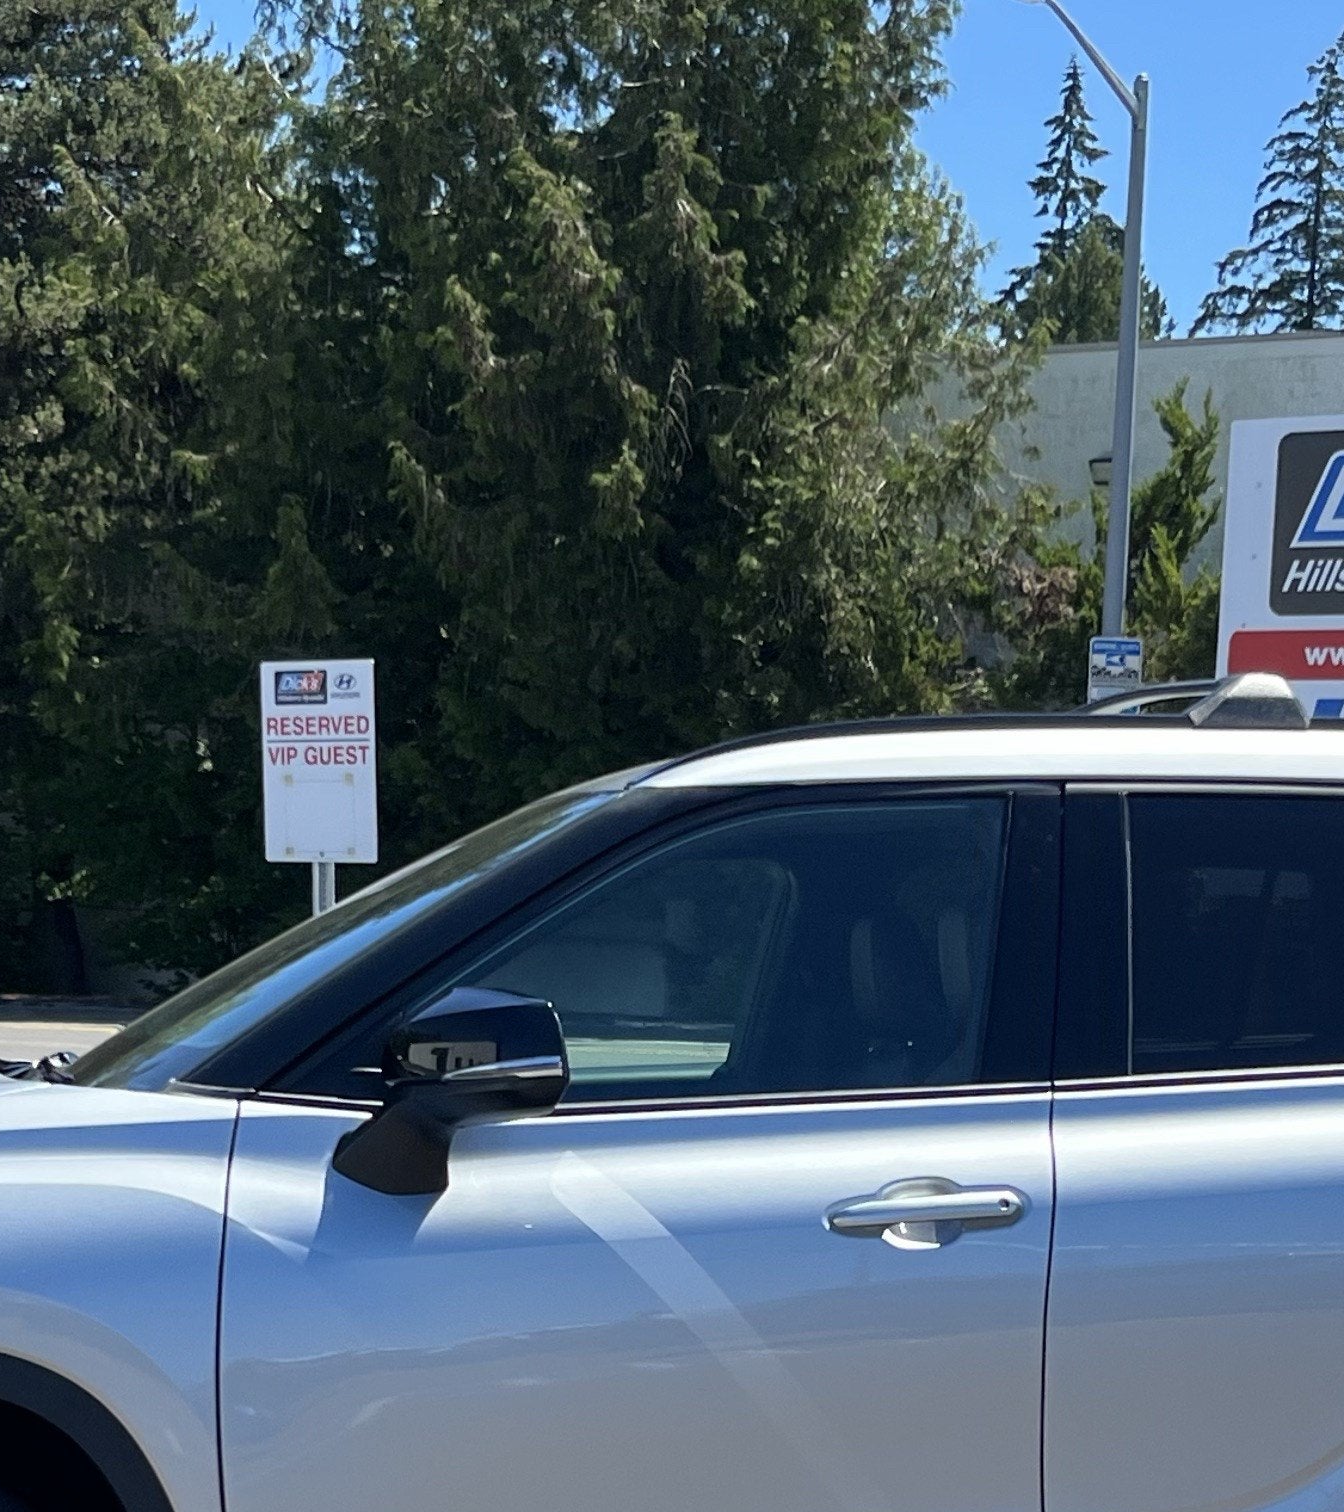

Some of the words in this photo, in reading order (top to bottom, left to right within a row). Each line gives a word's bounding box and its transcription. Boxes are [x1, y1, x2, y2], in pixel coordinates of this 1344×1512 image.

[266, 715, 370, 736] RESERVED
[268, 746, 298, 766] VIP
[304, 745, 370, 766] GUEST
